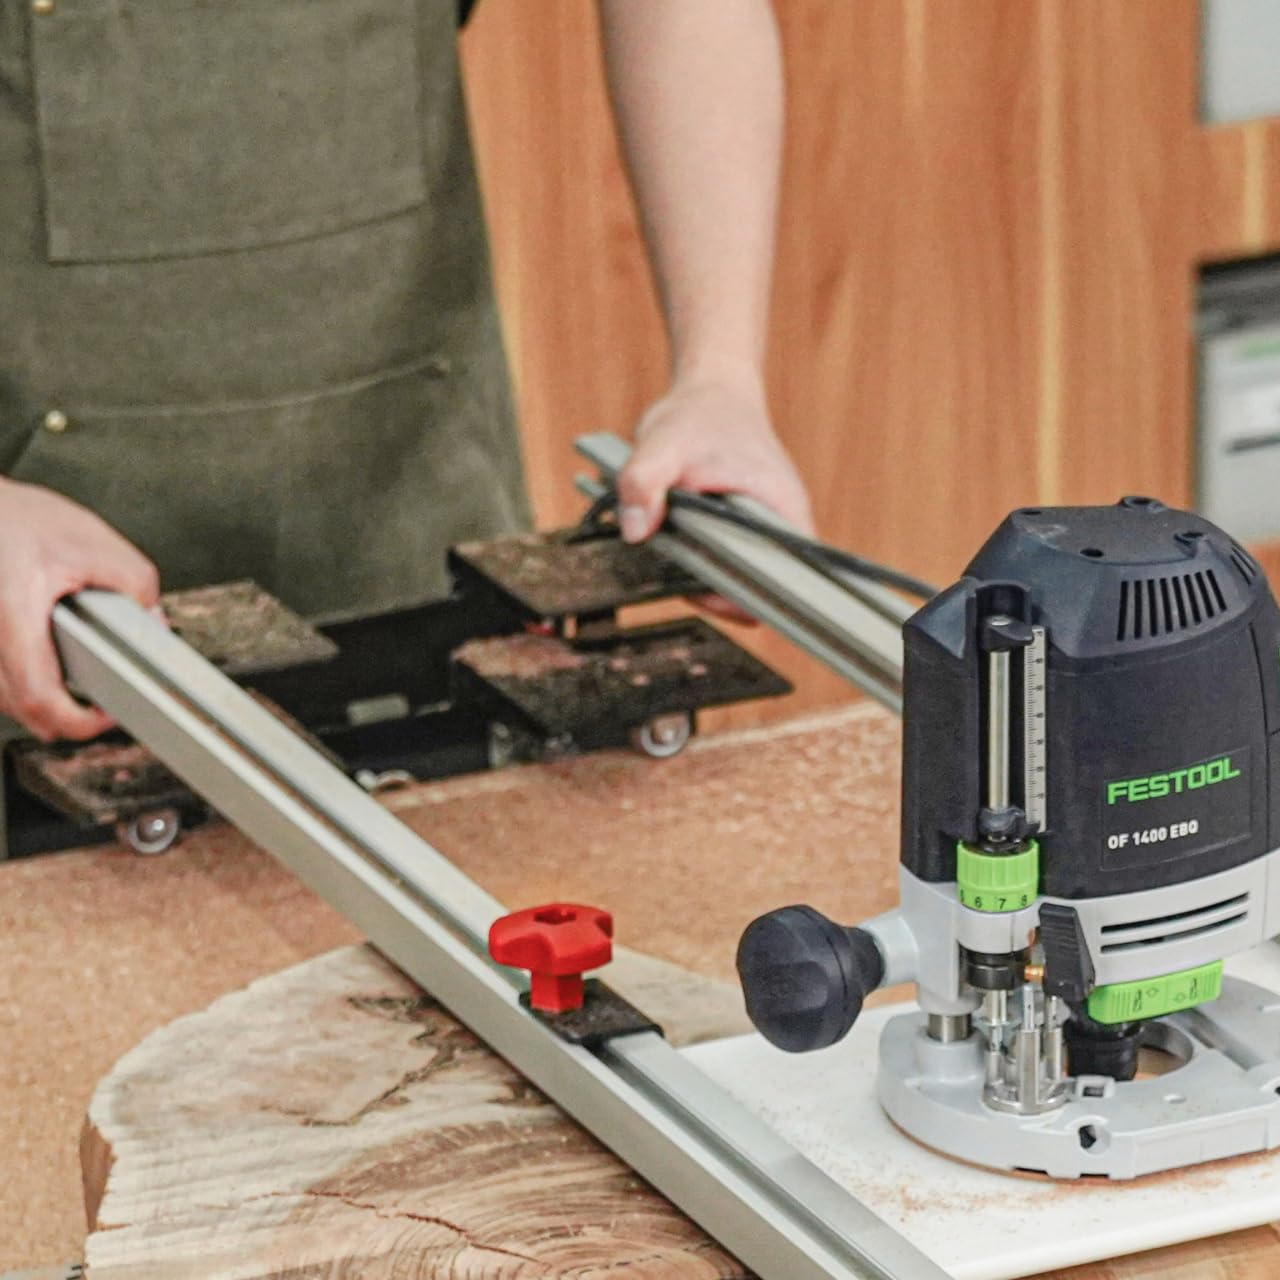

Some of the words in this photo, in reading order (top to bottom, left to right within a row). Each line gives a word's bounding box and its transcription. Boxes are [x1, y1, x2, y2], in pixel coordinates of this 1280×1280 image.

[1107, 757, 1241, 805] FESTOOL
[1107, 833, 1129, 849] OF
[1132, 827, 1168, 846] 1400
